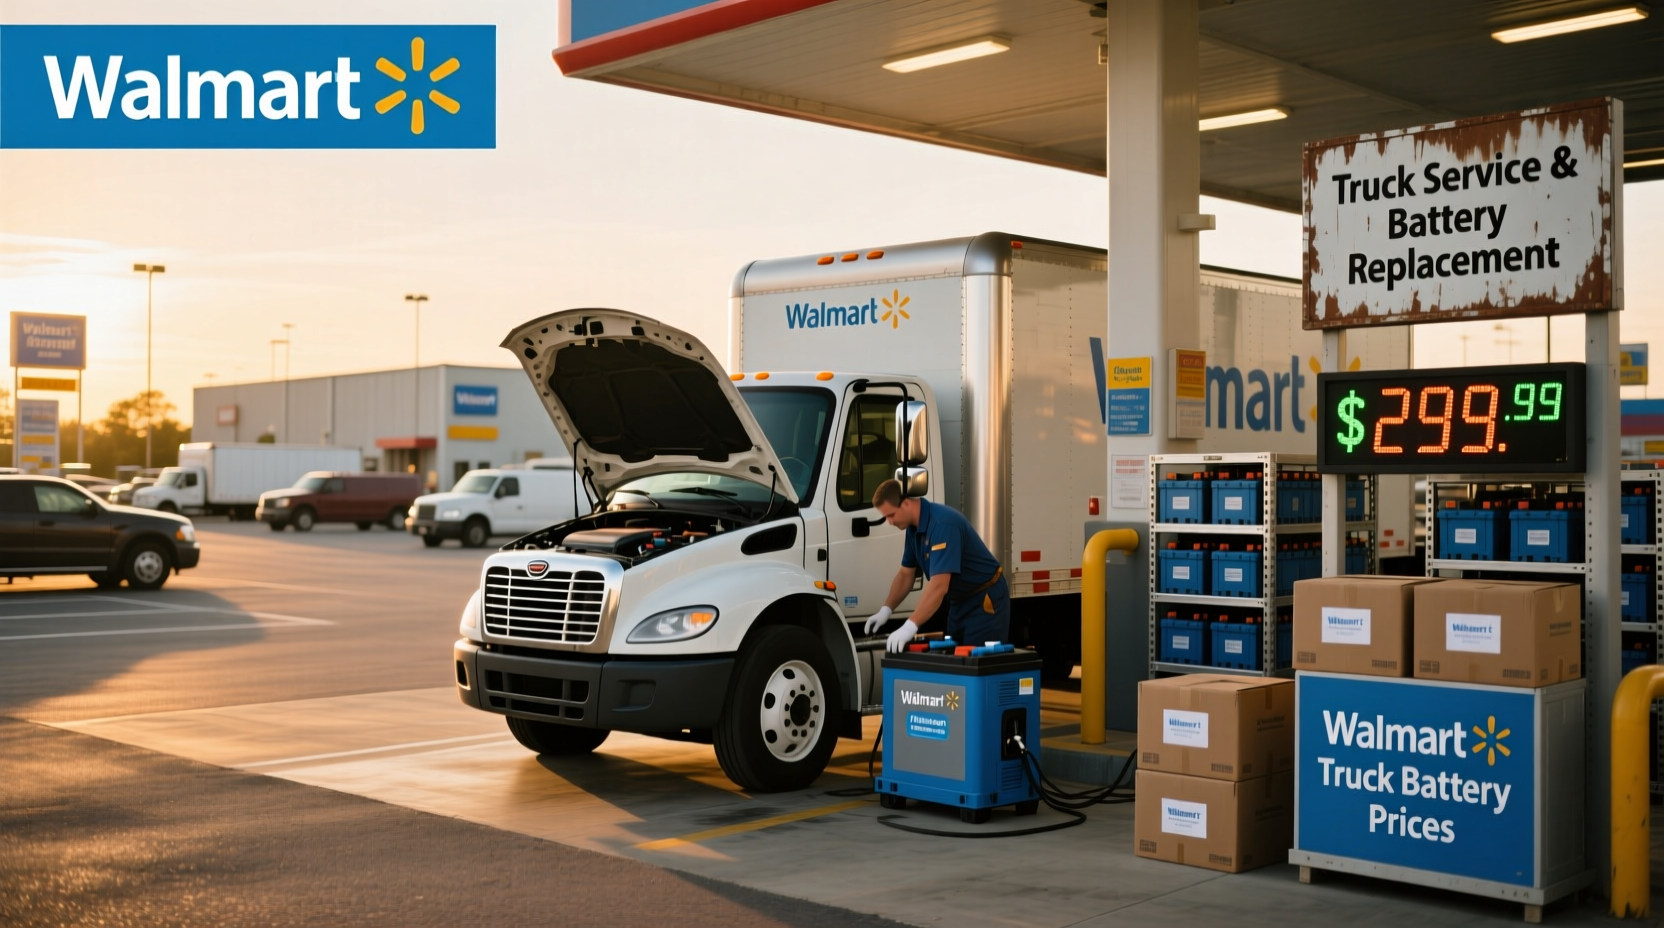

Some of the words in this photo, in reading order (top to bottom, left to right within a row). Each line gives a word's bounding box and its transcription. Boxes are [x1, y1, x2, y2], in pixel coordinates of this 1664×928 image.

[1332, 165, 1416, 205] Truck
[1423, 152, 1541, 194] Service
[1550, 145, 1578, 179] &
[1388, 204, 1507, 239] Battery
[1348, 237, 1560, 291] Replacement
[785, 297, 878, 329] Walmart
[1322, 710, 1466, 758] Walmart
[1318, 757, 1394, 794] Truck
[1402, 766, 1511, 815] Battery
[1369, 804, 1455, 843] Prices
